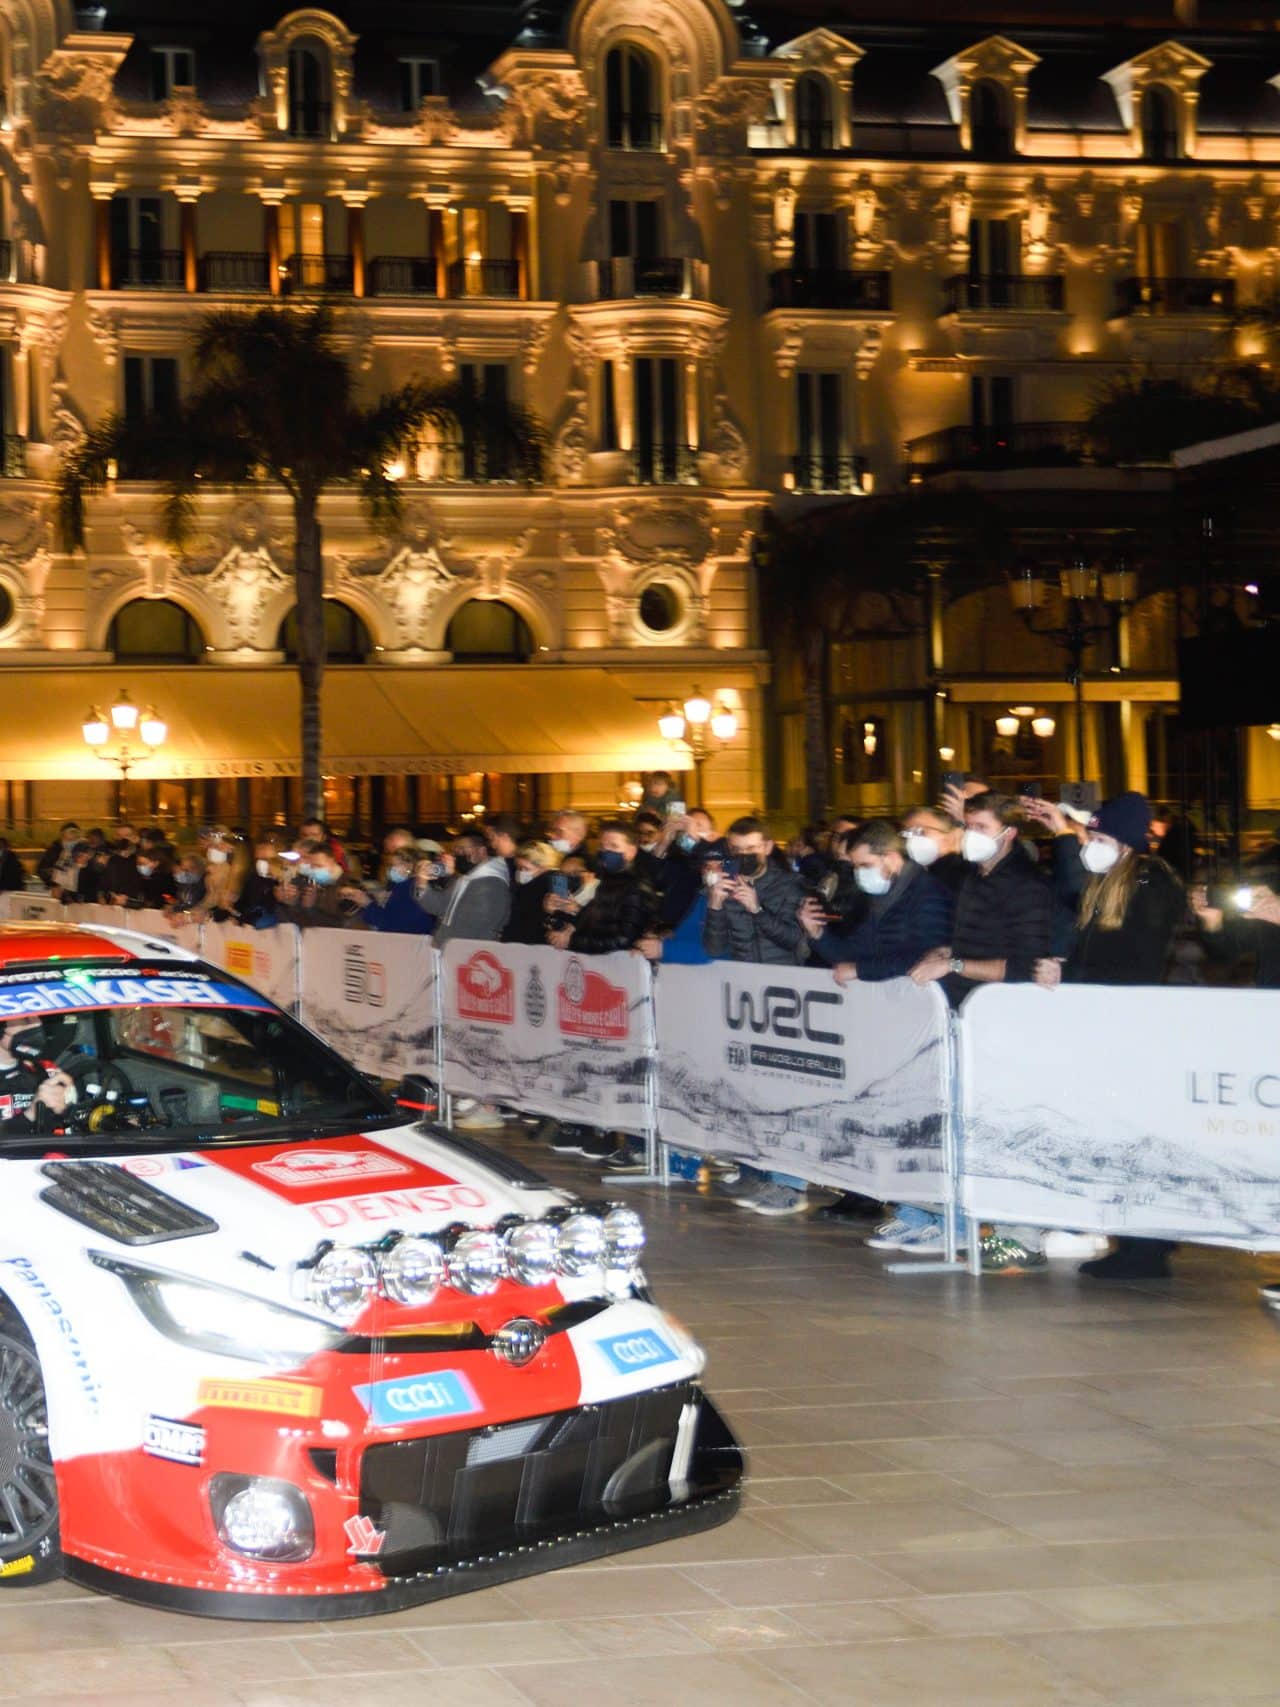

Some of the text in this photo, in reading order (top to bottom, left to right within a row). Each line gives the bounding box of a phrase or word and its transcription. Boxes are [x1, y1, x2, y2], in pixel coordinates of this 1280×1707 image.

[723, 980, 845, 1046] WRC
[1189, 1070, 1239, 1106] LE
[308, 1185, 489, 1229] DENSO
[0, 1256, 99, 1414] Panasonic
